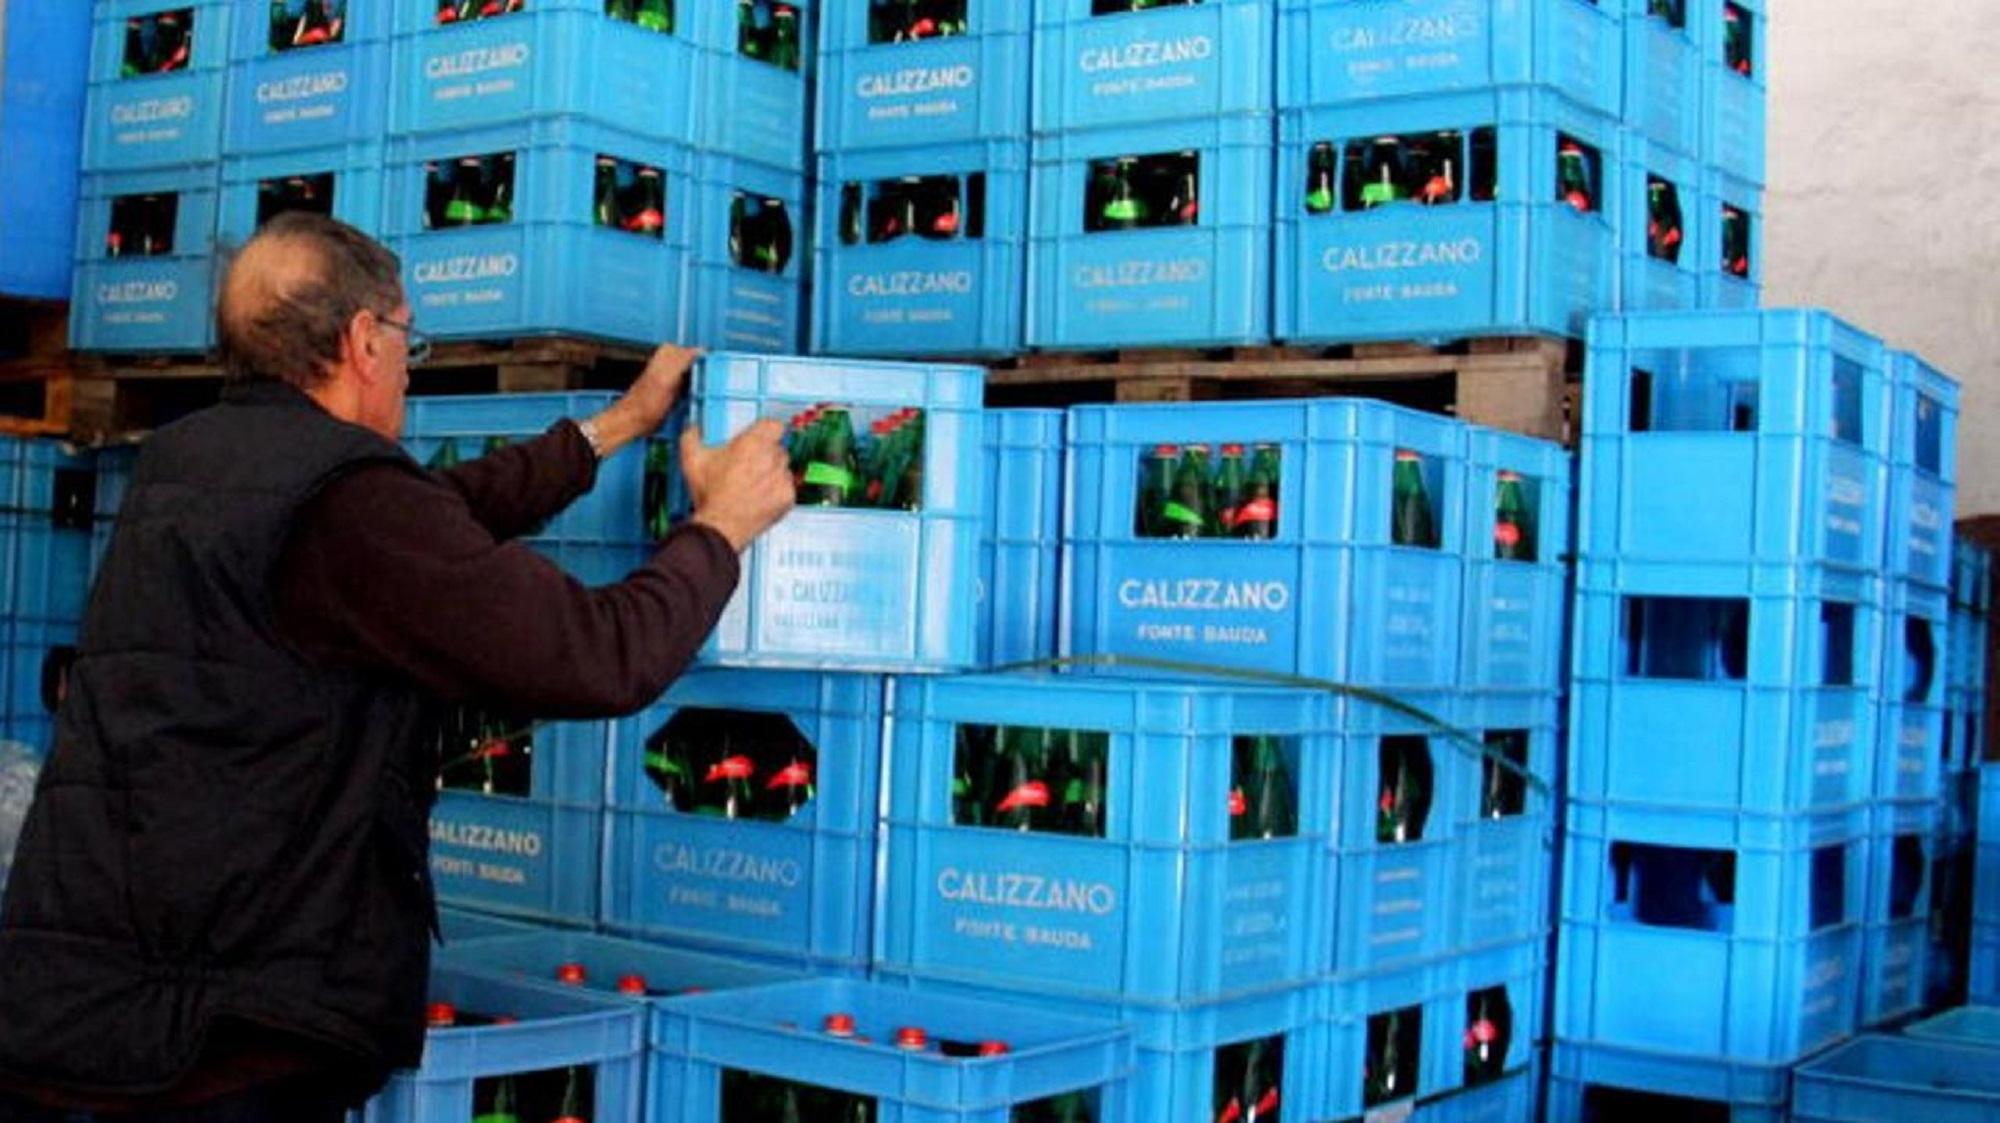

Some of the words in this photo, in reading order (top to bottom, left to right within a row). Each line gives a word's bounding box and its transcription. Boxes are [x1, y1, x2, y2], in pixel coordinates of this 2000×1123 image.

[1080, 36, 1211, 72] CALIZZANO
[857, 65, 973, 98] CALIZZANO
[414, 254, 518, 284] CALIZZANO
[1322, 238, 1481, 272] CALIZZANO
[849, 271, 972, 296] CALIZZANO
[1119, 579, 1289, 610] CALIZZANO
[1136, 622, 1195, 642] FONTE
[1203, 624, 1268, 645] BAUDA
[427, 817, 542, 857] ALIZZANO
[654, 843, 800, 887] CALIZZANO
[937, 867, 1115, 915] CALIZZANO
[954, 917, 1016, 942] FONTE
[1023, 926, 1092, 950] BAUDA
